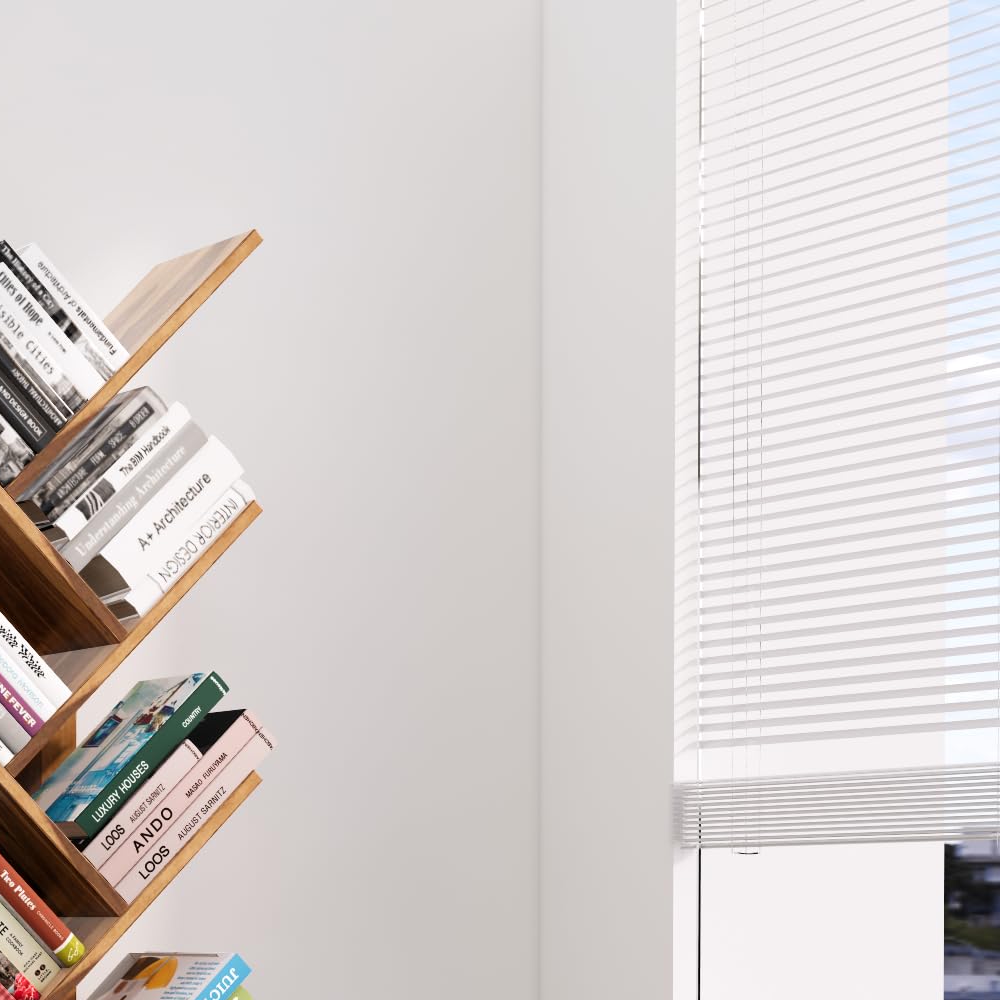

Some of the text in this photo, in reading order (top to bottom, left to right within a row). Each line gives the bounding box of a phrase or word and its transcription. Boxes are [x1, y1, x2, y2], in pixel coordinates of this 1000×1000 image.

[37, 261, 71, 301] Architecture
[15, 293, 25, 305] of
[22, 302, 44, 326] Hope
[76, 305, 118, 356] Fundamentals
[25, 339, 54, 375] Cities
[0, 383, 12, 401] AND
[9, 397, 29, 422] DESIGN
[26, 418, 44, 438] BOOK
[118, 425, 172, 478] The BIM Handbook
[74, 447, 187, 557] Understanding Architecture
[136, 473, 212, 552] A+ Architecture
[158, 497, 239, 583] INTERIOR DESIGN
[16, 644, 47, 679] White
[7, 695, 37, 729] FEVER
[181, 705, 202, 728] COUNTRY
[91, 760, 150, 823] LUXURY HOUSES
[100, 783, 166, 851] LOOS AUGUST SARNITZ
[132, 751, 229, 854] ANDO MASAO FURUYAMA
[138, 785, 228, 881] LOOS AUGUST SARNITZ
[13, 883, 38, 912] Plates
